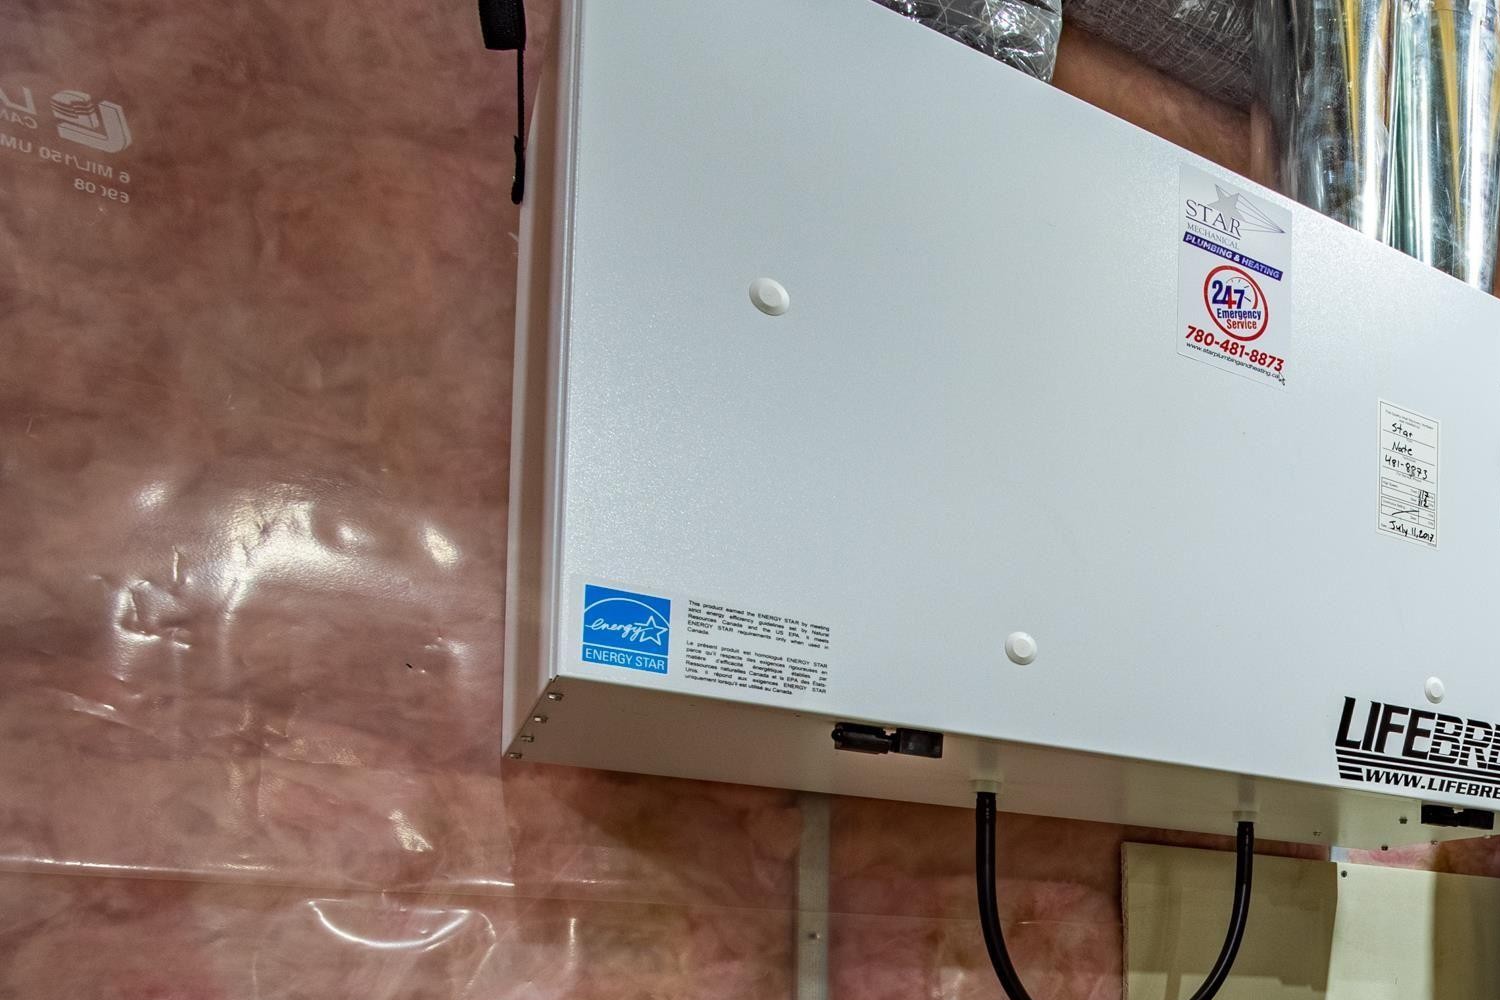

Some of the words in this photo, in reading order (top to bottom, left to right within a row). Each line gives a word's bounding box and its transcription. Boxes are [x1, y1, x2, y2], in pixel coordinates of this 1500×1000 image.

[1186, 199, 1242, 237] STAR
[1188, 222, 1240, 249] MECHANICAL
[1186, 234, 1233, 262] PLUMBING
[1234, 254, 1241, 263] &
[1242, 257, 1280, 280] HEATING
[1217, 308, 1262, 322] Emergency
[1227, 318, 1257, 330] Service
[1185, 325, 1284, 372] 780-481-8873
[1392, 422, 1413, 438] Star
[1389, 520, 1409, 538] July
[688, 613, 717, 623] Resources
[722, 620, 743, 628] Canada
[703, 603, 723, 613] product
[726, 607, 744, 615] earned
[758, 613, 781, 623] ENERGY
[810, 624, 830, 633] meeting
[706, 611, 725, 619] energy
[730, 614, 754, 625] efficiency
[759, 620, 784, 631] guidelines
[812, 630, 829, 638] Natural
[588, 618, 643, 641] energy
[688, 620, 713, 629] ENERGY
[718, 625, 734, 633] STAR
[738, 629, 771, 641] requirements
[776, 636, 786, 644] only
[586, 649, 633, 666] ENERGY
[636, 657, 664, 671] STAR
[720, 652, 743, 662] respecte
[721, 646, 740, 655] produit
[787, 657, 810, 666] ENERGY
[686, 659, 717, 669] Ressources
[749, 670, 769, 678] Canada
[784, 683, 807, 691] ENERGY
